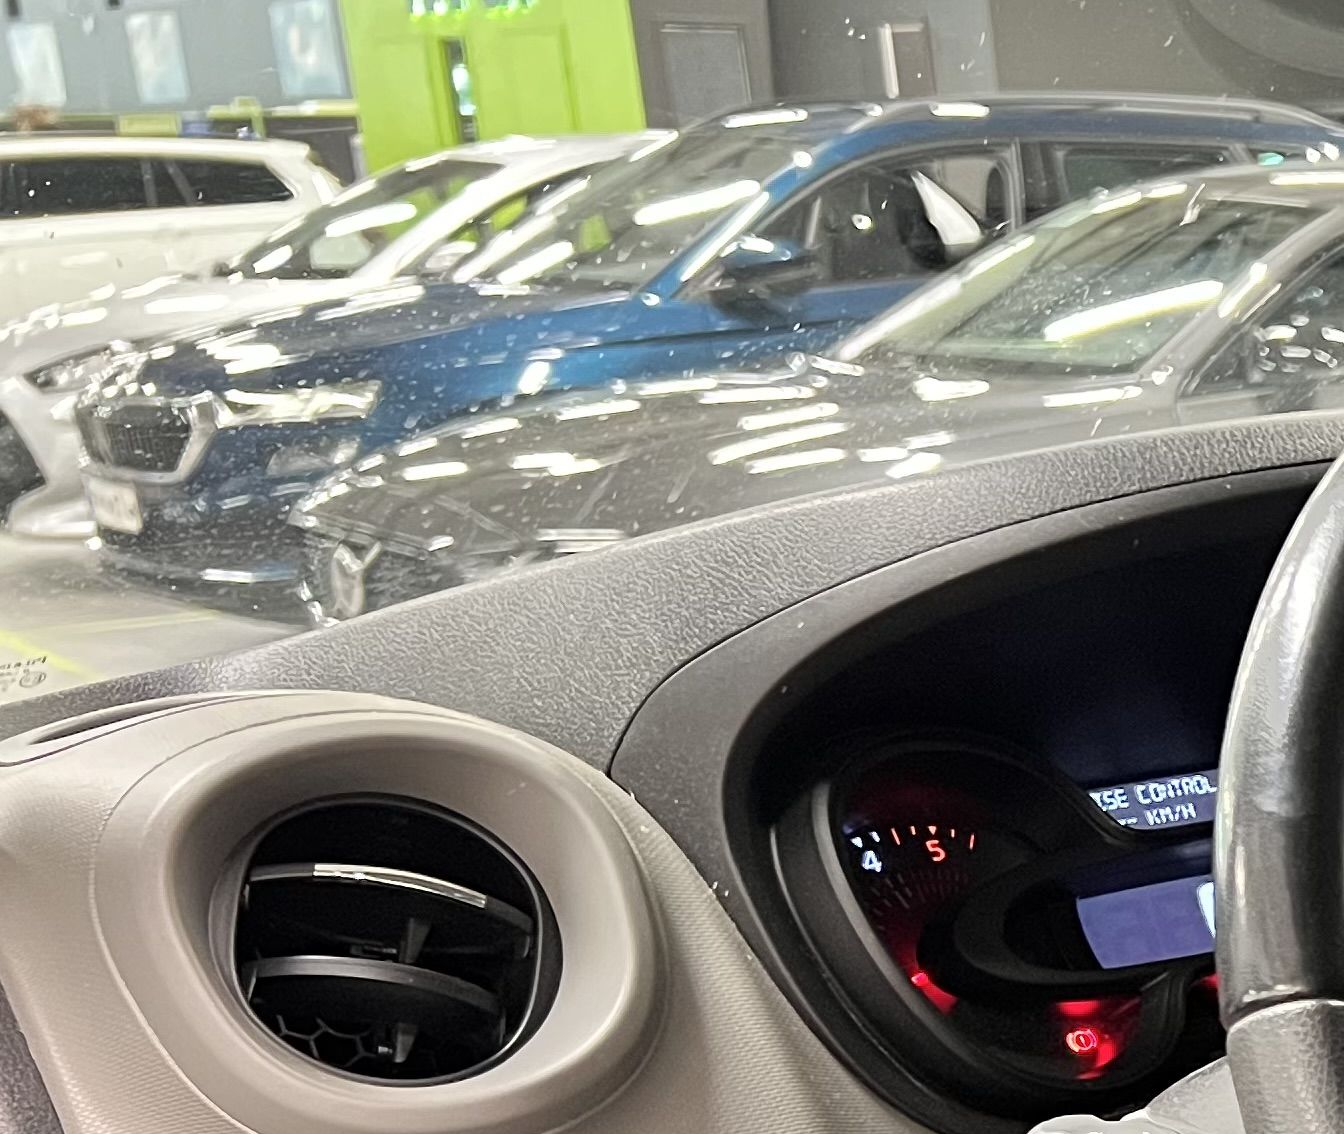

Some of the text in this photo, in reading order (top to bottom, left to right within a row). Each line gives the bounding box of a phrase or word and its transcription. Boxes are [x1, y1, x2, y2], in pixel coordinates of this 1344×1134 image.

[1134, 774, 1218, 804] CONTROL
[861, 839, 946, 873] 4 5
